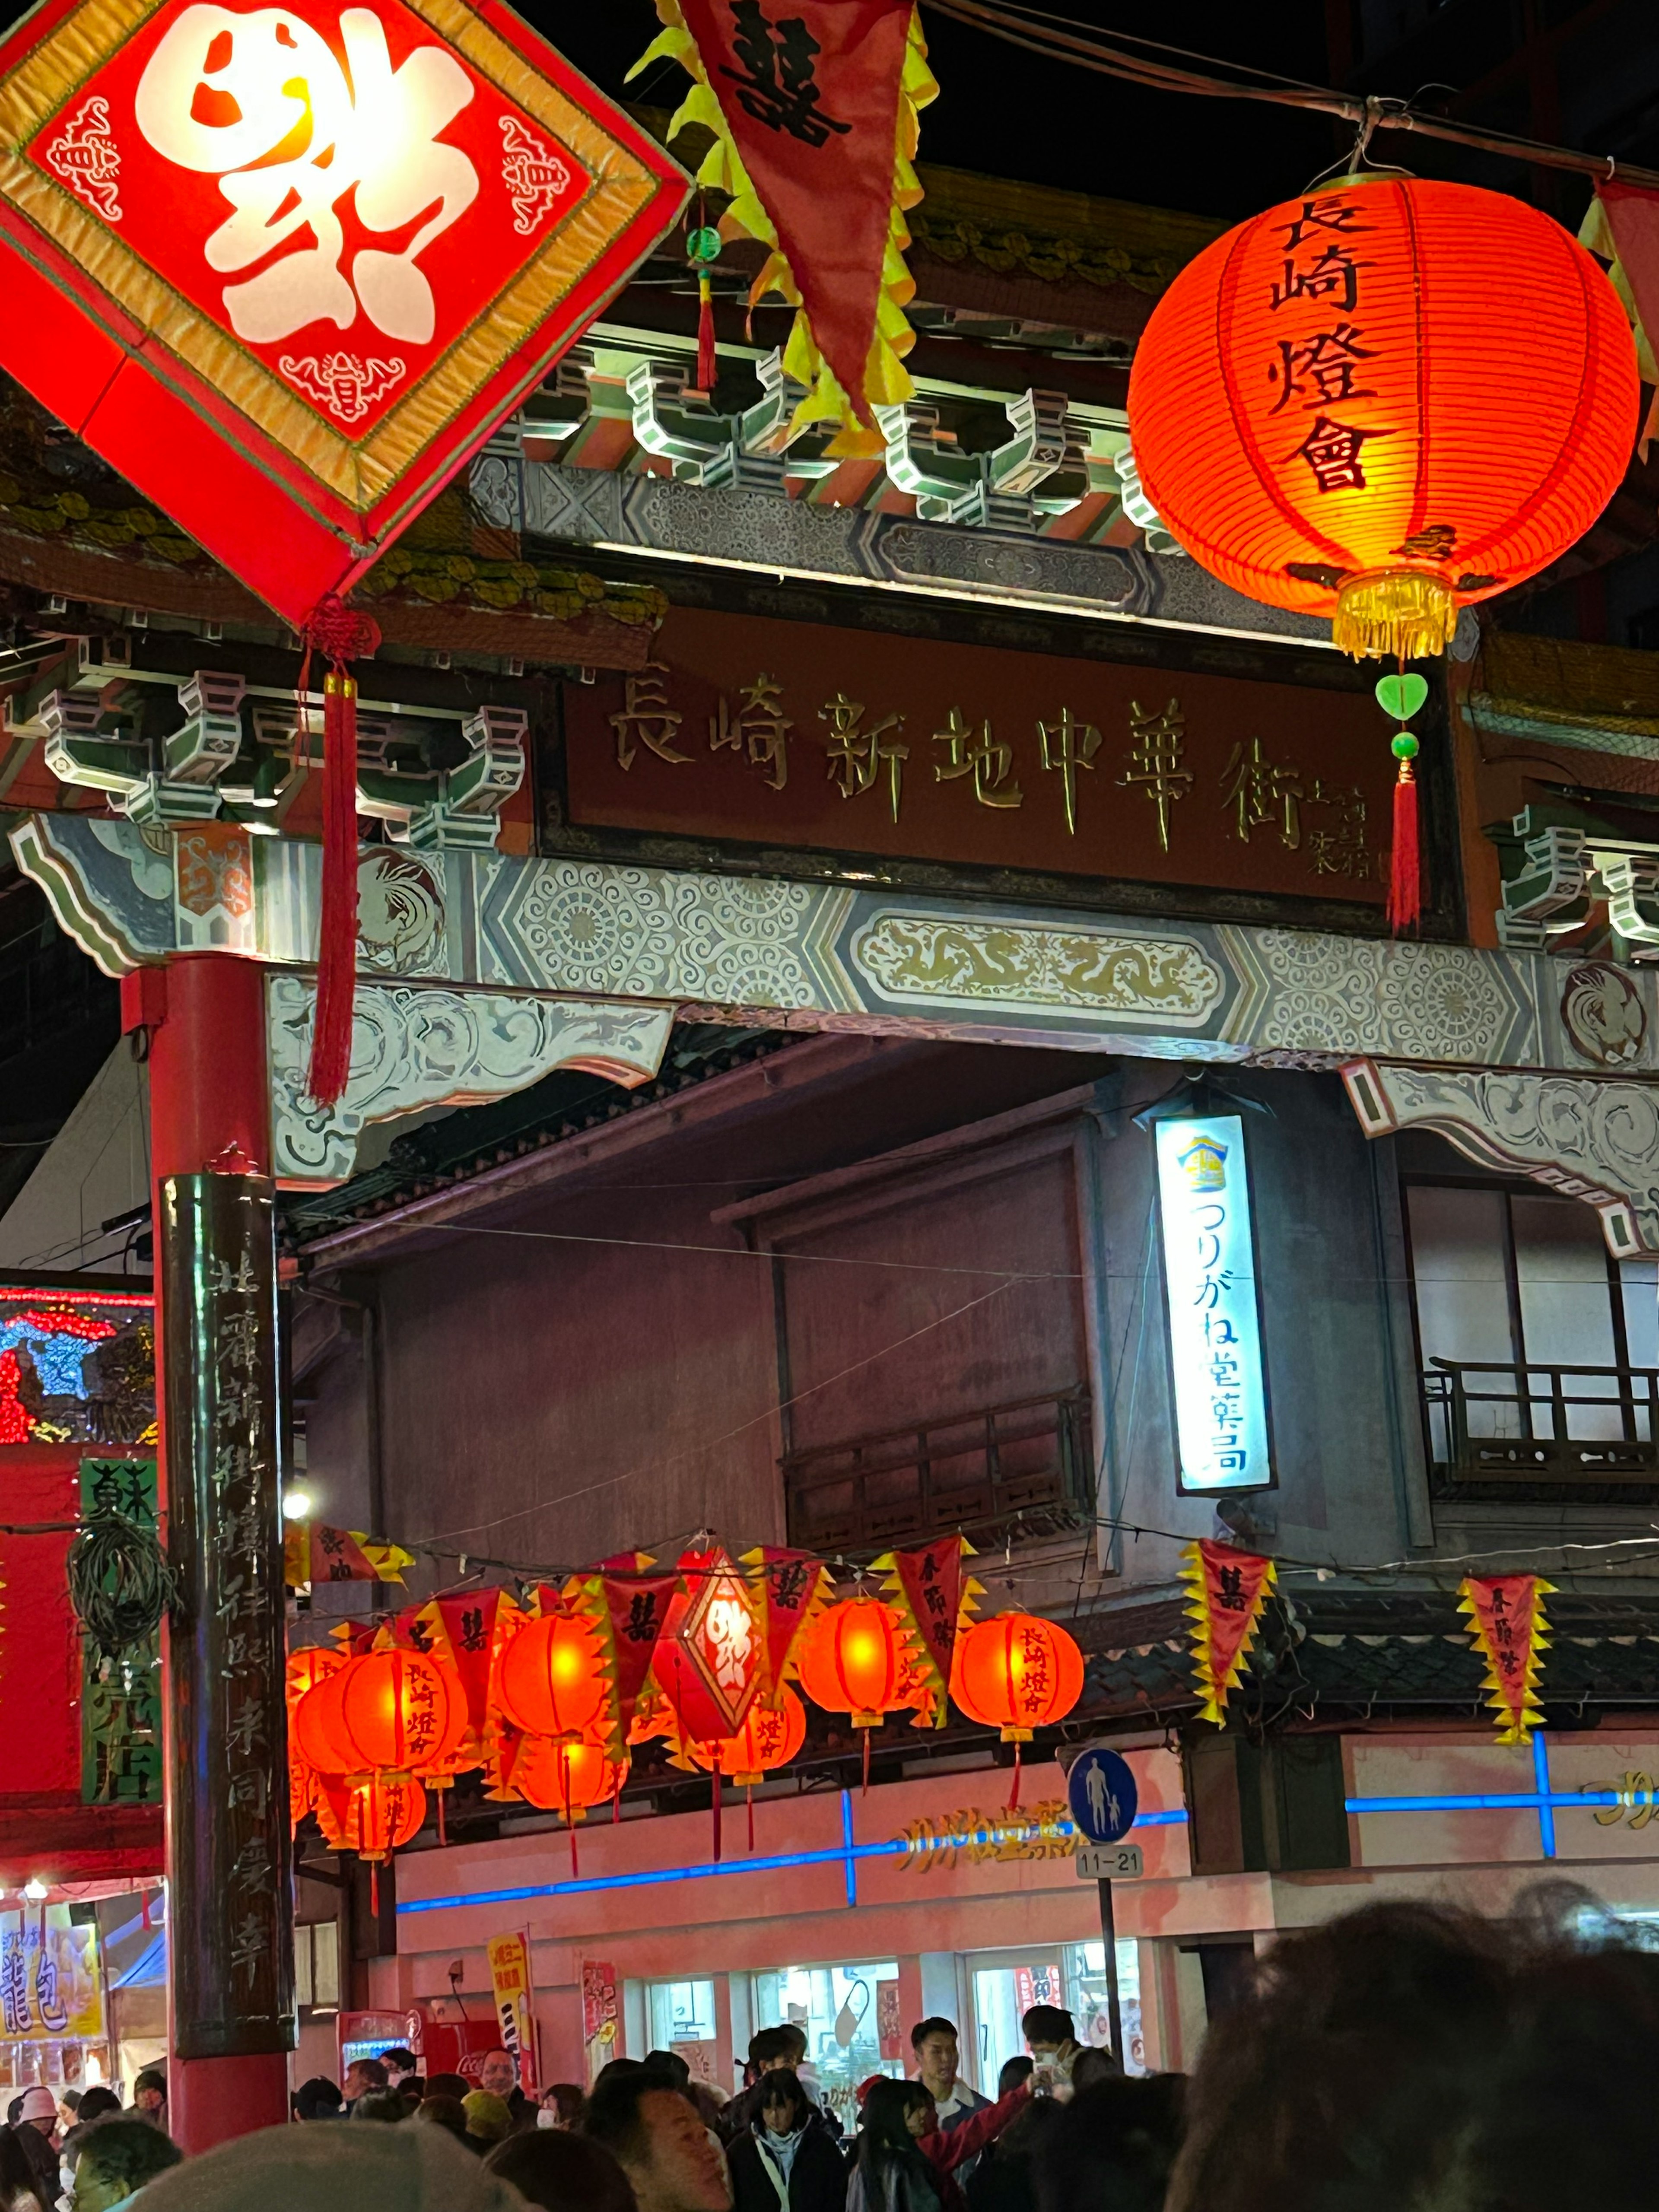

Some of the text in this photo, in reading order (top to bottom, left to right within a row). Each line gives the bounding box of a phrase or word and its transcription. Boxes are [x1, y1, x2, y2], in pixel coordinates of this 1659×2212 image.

[135, 1, 479, 345] 福
[1267, 192, 1400, 493] 長崎燈會
[607, 661, 1305, 855] 長崎新地中華街
[1190, 1204, 1247, 1471] つりがね堂薬局
[1081, 1852, 1139, 1872] 11-21
